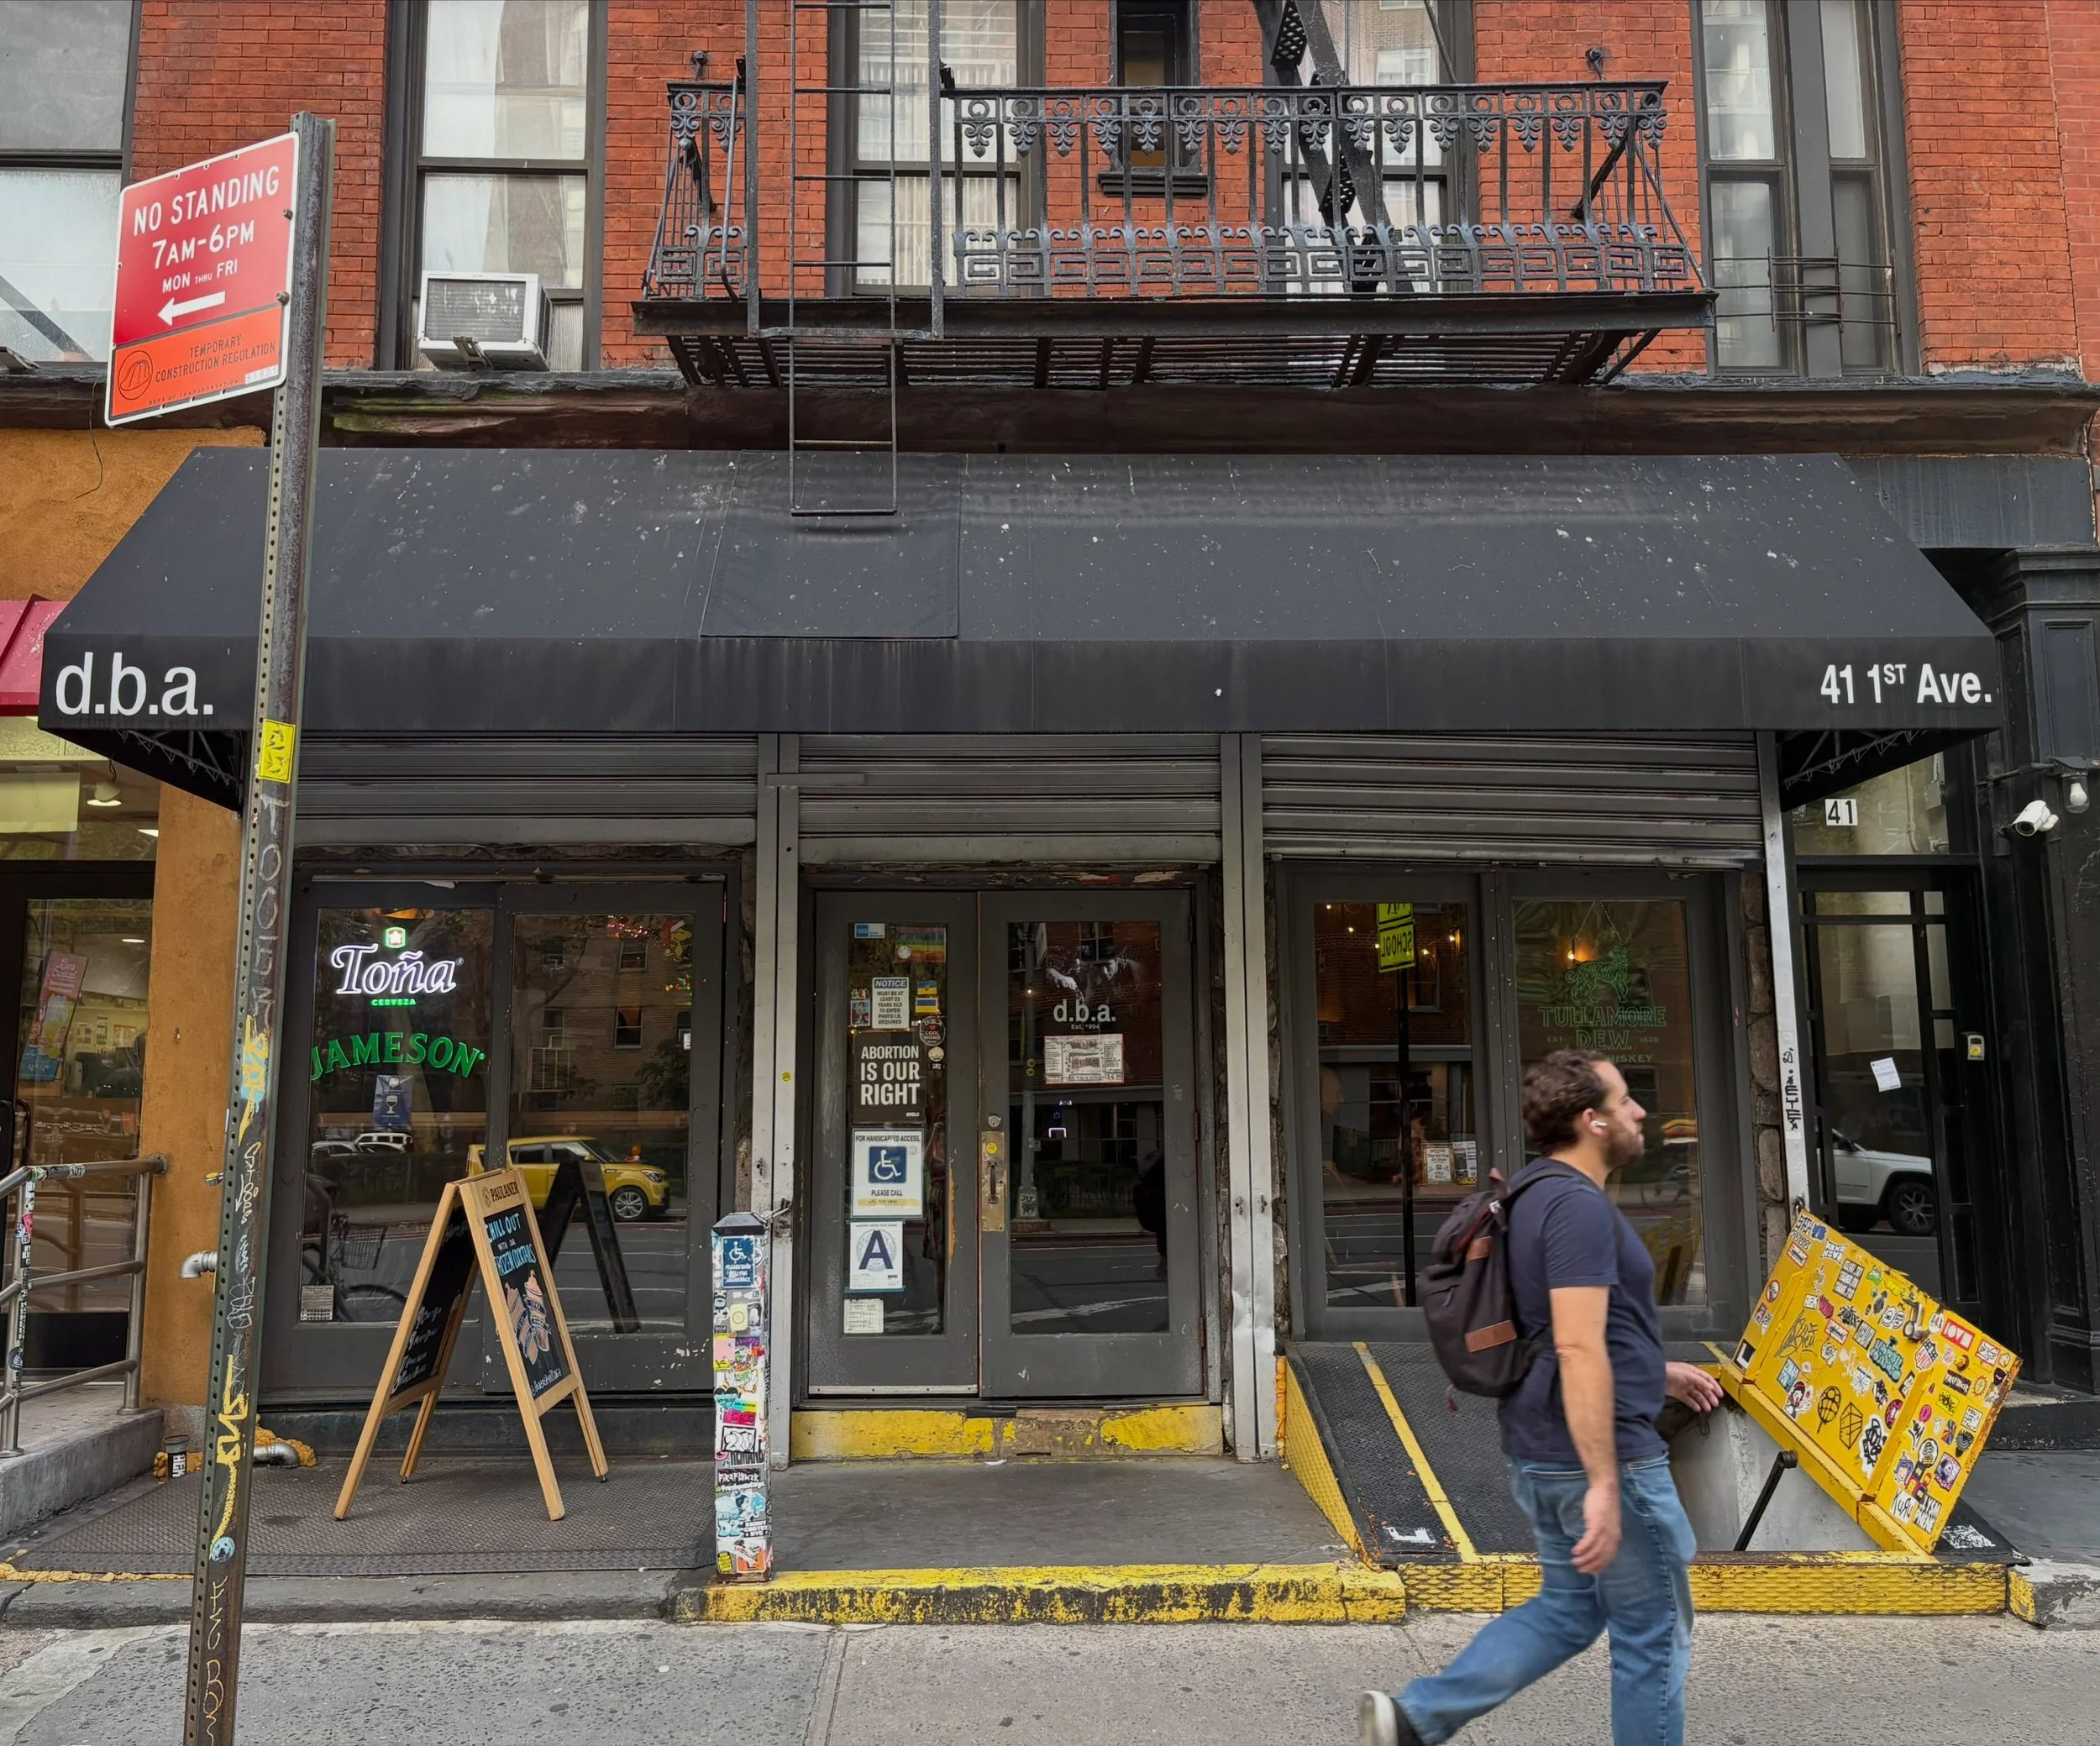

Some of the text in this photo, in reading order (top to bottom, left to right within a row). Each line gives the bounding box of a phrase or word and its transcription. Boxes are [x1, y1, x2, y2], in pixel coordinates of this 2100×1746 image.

[134, 165, 280, 236] NO STANDING
[152, 221, 255, 270] 7AM-6PM
[162, 259, 238, 293] MON THRU FRI
[189, 335, 242, 359] TEMPORARY
[155, 340, 276, 383] CONSTRUCTION REGULATION
[55, 651, 213, 716] d.b.a.
[1820, 663, 1992, 704] 41 1ST Ave.
[1827, 800, 1854, 824] 41
[875, 979, 906, 988] NOTICE
[371, 998, 417, 1007] CERVEZA
[1053, 999, 1116, 1023] d.b.a.
[1538, 1006, 1667, 1027] TULLAMORE
[1576, 1030, 1633, 1051] D.E.W.
[309, 1031, 480, 1082] JAMESON
[861, 1046, 919, 1060] ABORTION
[861, 1062, 921, 1081] IS OUR
[861, 1083, 921, 1105] RIGHT
[490, 1182, 520, 1202] PAULANER
[505, 1213, 521, 1235] OUT
[858, 1230, 894, 1270] A
